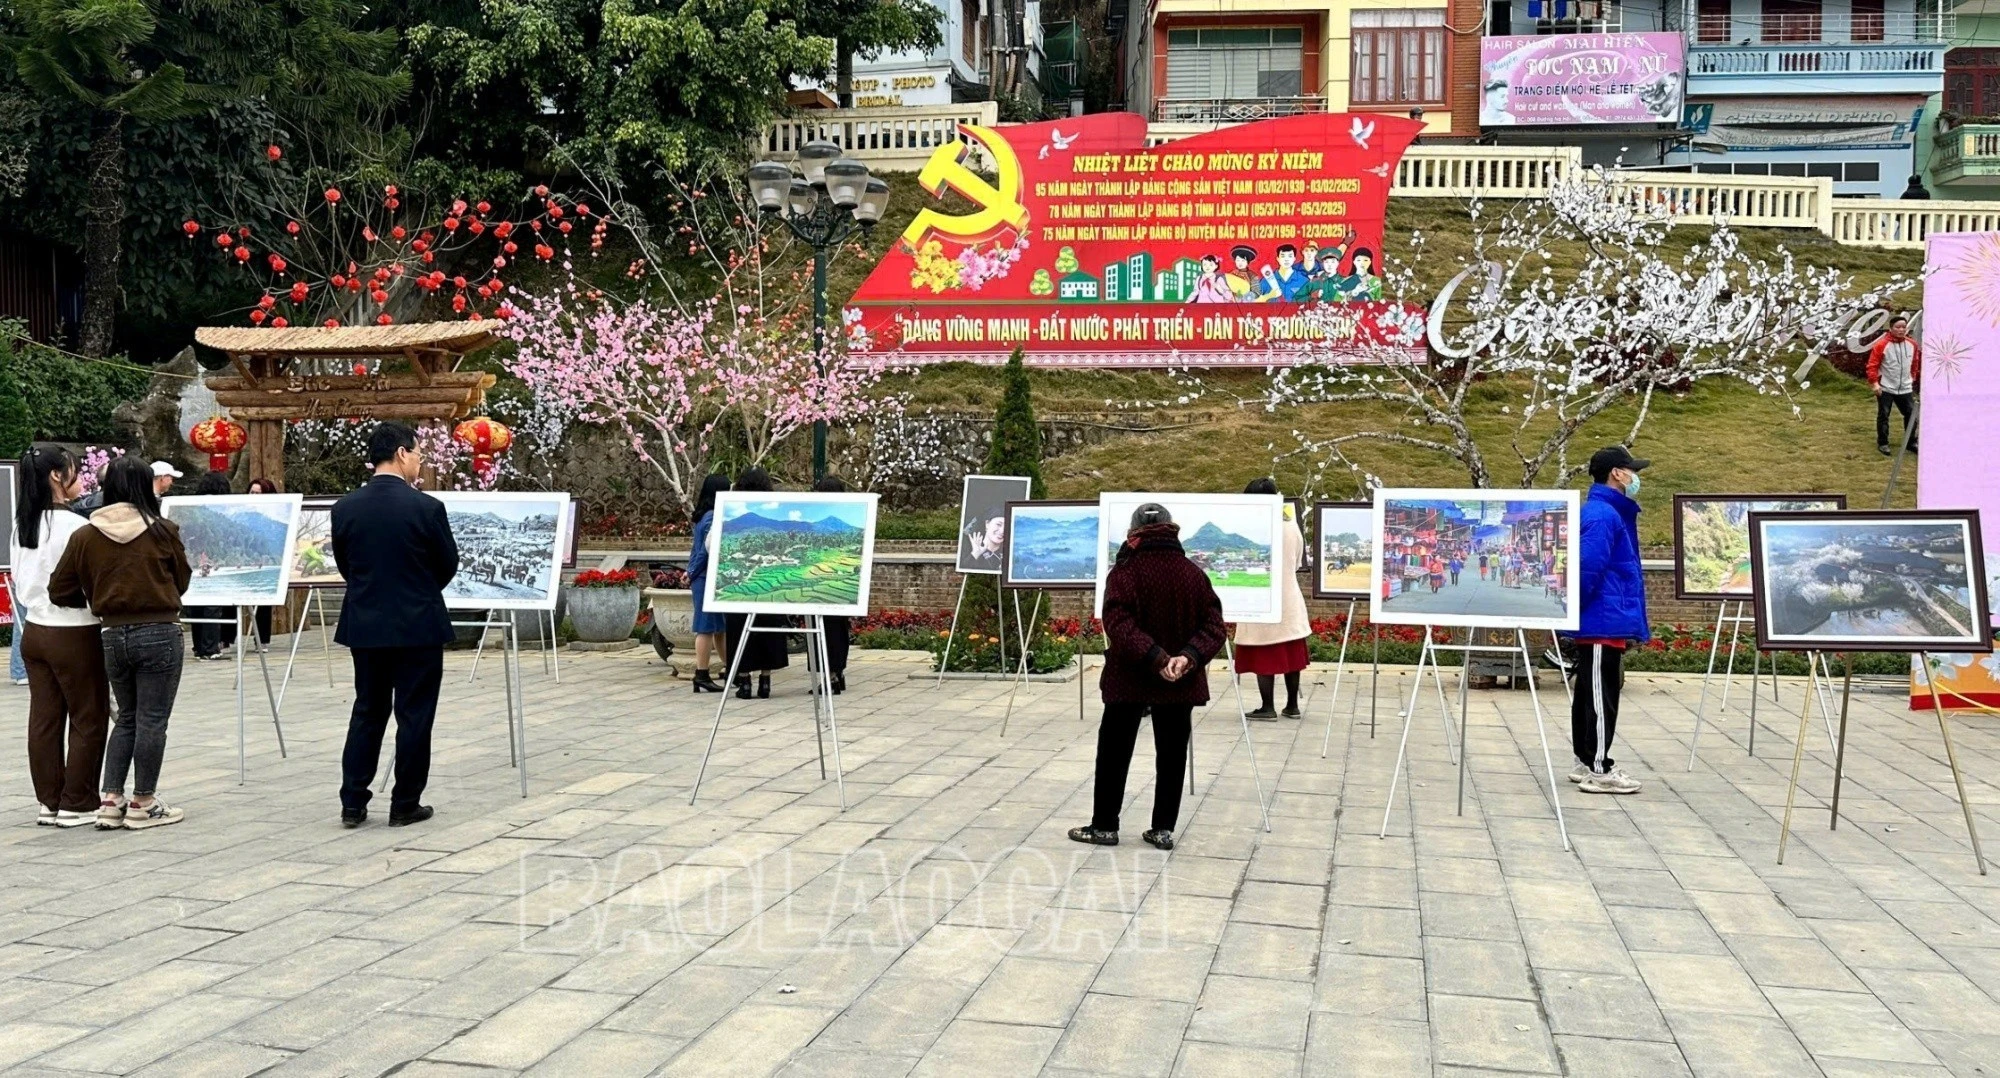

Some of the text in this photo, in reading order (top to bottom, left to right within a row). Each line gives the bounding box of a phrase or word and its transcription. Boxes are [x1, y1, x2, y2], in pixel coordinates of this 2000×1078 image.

[1484, 40, 1512, 50] HAIR
[1517, 38, 1556, 48] SALON
[1562, 38, 1597, 50] MAI
[1525, 55, 1564, 76] TÓC
[1570, 56, 1620, 75] NAM
[1639, 53, 1668, 74] NỮ
[892, 75, 935, 90] PHOTO
[1514, 86, 1543, 96] TRANG
[1546, 82, 1569, 95] ĐIỂM
[856, 95, 903, 107] BRIDAL
[1515, 102, 1527, 111] Hair
[1540, 102, 1551, 110] and
[1072, 148, 1323, 176] NHIỆT LIỆT CHÀO MỪNG KỶ NIỆM
[1035, 183, 1046, 196] 95
[1048, 180, 1068, 196] NĂM
[1069, 180, 1093, 196] NGÀY
[1095, 179, 1122, 196] THÀNH
[1124, 179, 1141, 198] LẬP
[1142, 177, 1166, 195] ĐẢNG
[1167, 179, 1190, 197] CỘNG
[1193, 176, 1211, 194] SẢN
[1213, 178, 1231, 197] VIỆT
[1233, 181, 1253, 194] NAM
[1049, 205, 1059, 219] 78
[1061, 202, 1081, 218] NĂM
[1083, 202, 1106, 218] NGÀY
[1108, 202, 1136, 218] THÀNH
[1137, 201, 1154, 220] LẬP
[1155, 199, 1179, 218] ĐẢNG
[1181, 201, 1193, 220] BỘ
[1216, 200, 1233, 217] LÀO
[1234, 203, 1249, 216] CAI
[1251, 202, 1296, 217] (05/3/1947
[1301, 201, 1347, 217] 05/3/2025)
[1043, 228, 1053, 240] 75
[1055, 225, 1075, 240] NĂM
[1077, 225, 1100, 240] NGÀY
[1102, 224, 1130, 240] THÀNH
[1131, 224, 1148, 242] LẬP
[1149, 222, 1173, 240] ĐẢNG
[1174, 223, 1187, 242] BỘ
[1188, 223, 1216, 242] HUYỆN
[1218, 220, 1236, 239] BẮC
[1238, 222, 1249, 239] HÀ
[1251, 225, 1296, 239] (12/3/1950
[1302, 224, 1346, 239] 12/3/2025)
[946, 315, 984, 341] VỮNG
[988, 318, 1030, 346] MẠNH
[1070, 314, 1109, 341] NƯỚC
[1113, 313, 1149, 341] PHÁT
[1153, 308, 1194, 341] TRIỂN
[1204, 312, 1233, 340] DÂN
